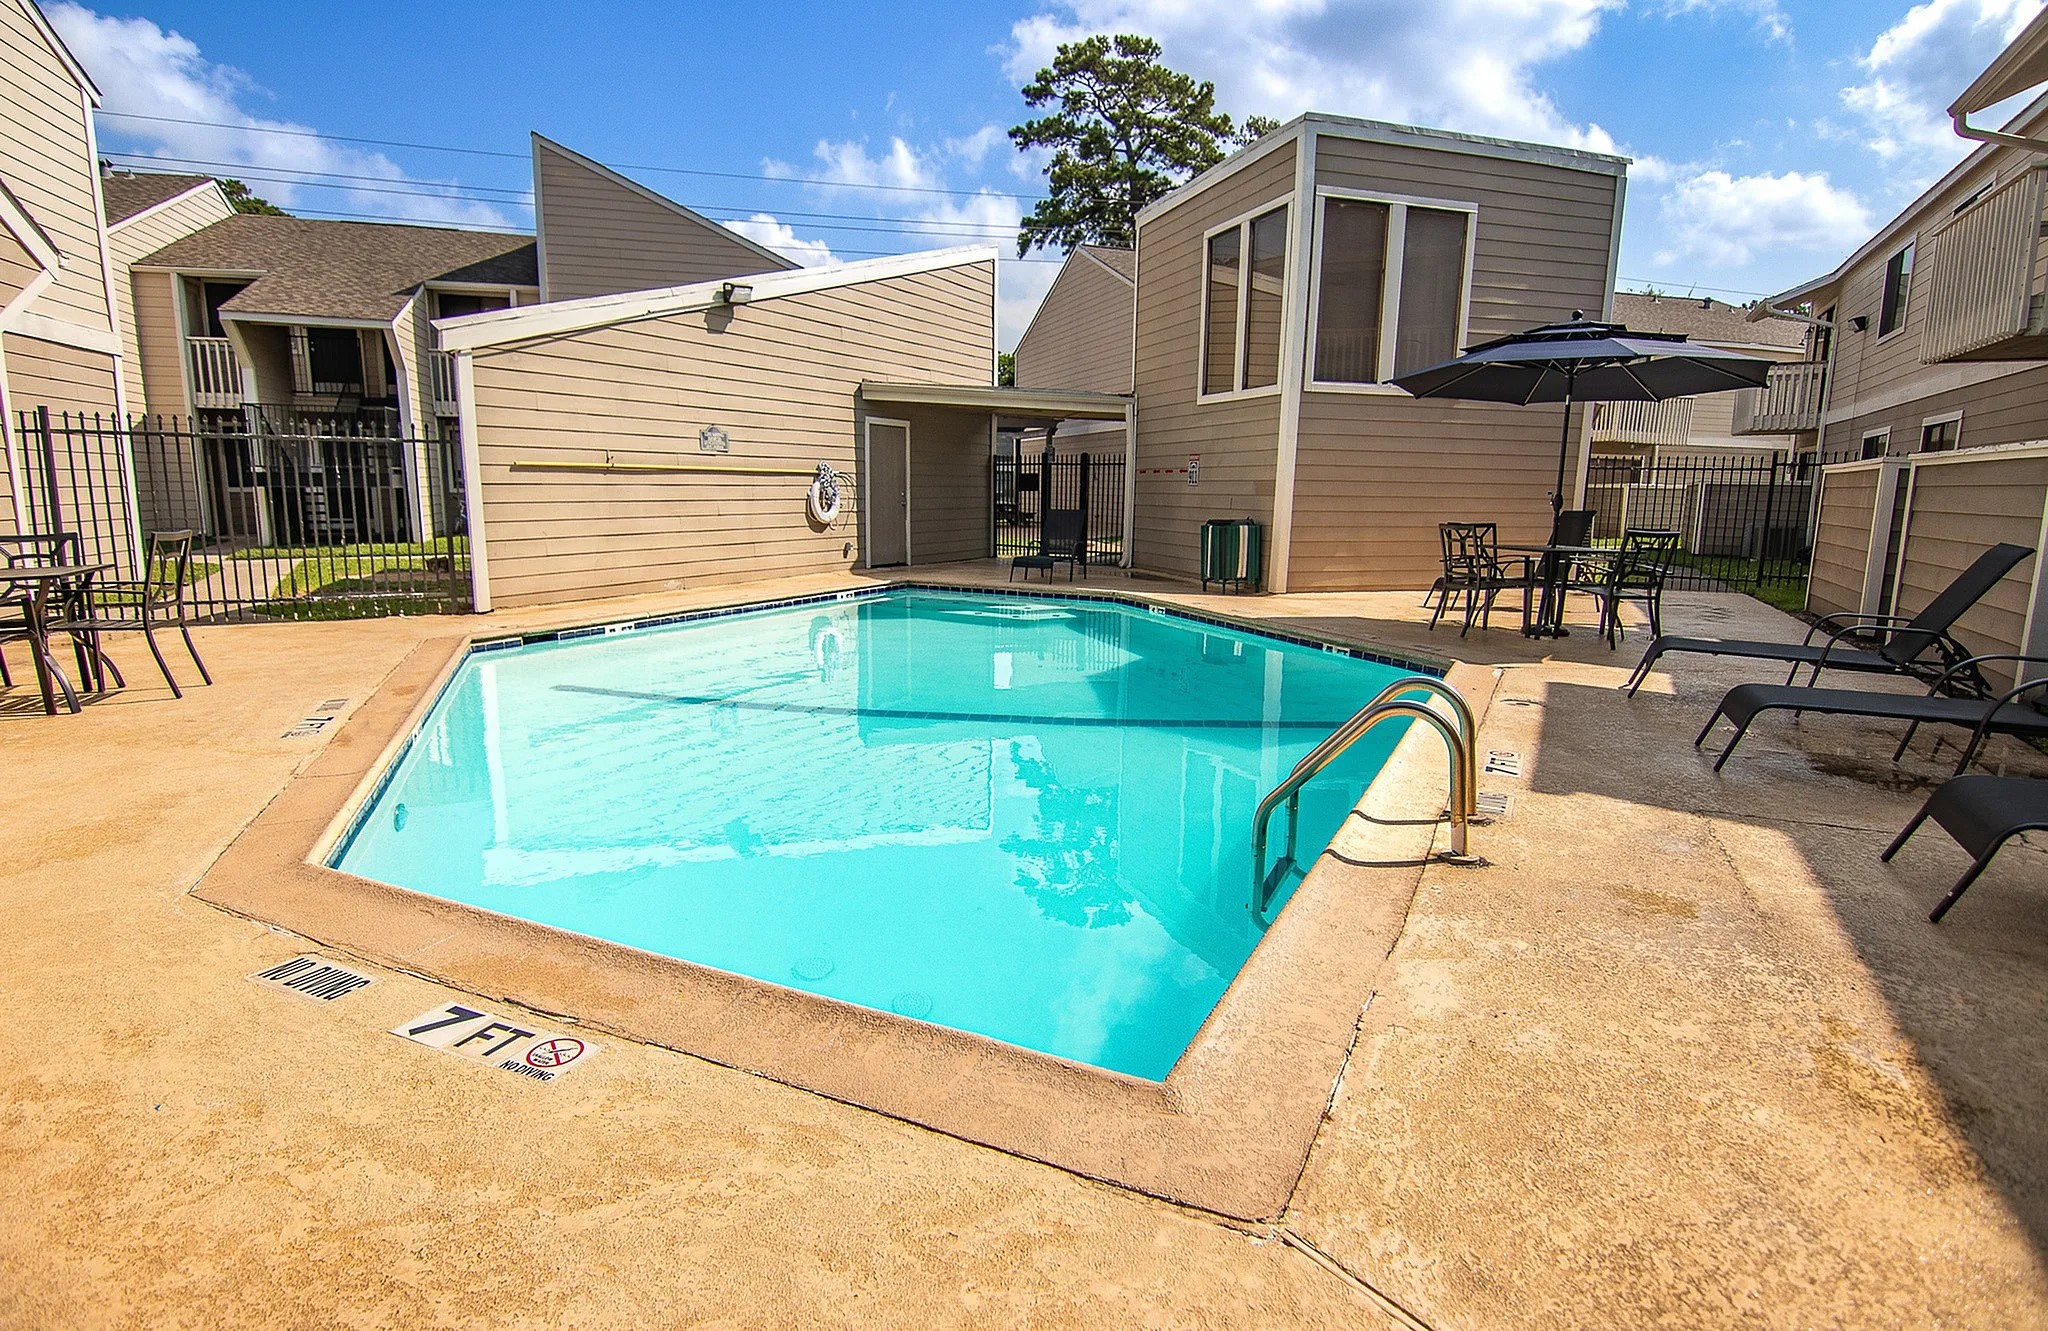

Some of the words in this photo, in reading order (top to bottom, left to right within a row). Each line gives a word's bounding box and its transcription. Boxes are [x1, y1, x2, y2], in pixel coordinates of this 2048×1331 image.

[258, 957, 317, 981] NO
[283, 966, 371, 1001] DIVING
[408, 1005, 487, 1036] 7
[453, 1022, 536, 1056] FT
[500, 1059, 520, 1071] NO
[514, 1064, 555, 1081] DIVING
